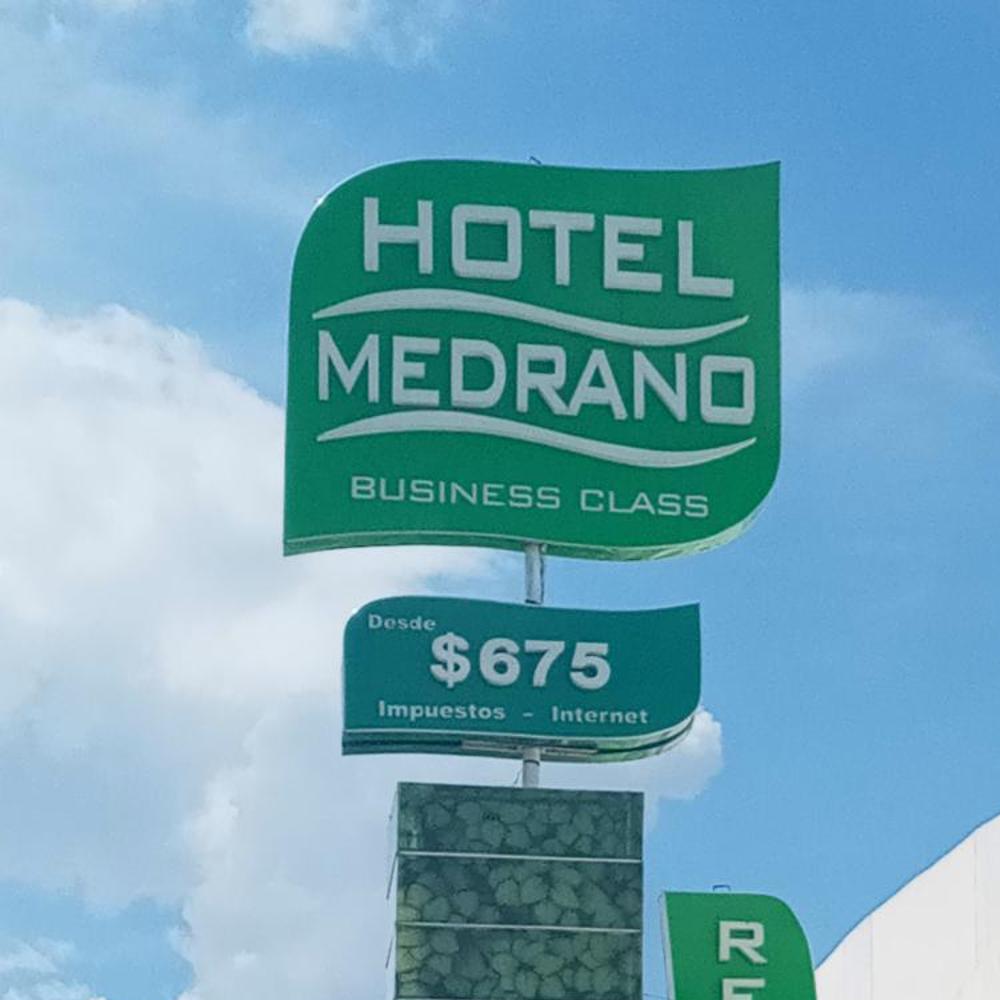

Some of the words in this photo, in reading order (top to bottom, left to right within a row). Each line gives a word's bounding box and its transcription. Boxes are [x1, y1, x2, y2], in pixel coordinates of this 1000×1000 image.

[363, 196, 734, 299] HOTEL
[316, 330, 756, 426] MEDRANO
[350, 475, 561, 511] BUSINESS
[579, 488, 709, 518] CLASS
[368, 613, 437, 632] Desde
[429, 632, 612, 689] $675
[378, 700, 506, 724] Impuestos
[551, 705, 648, 725] Internet
